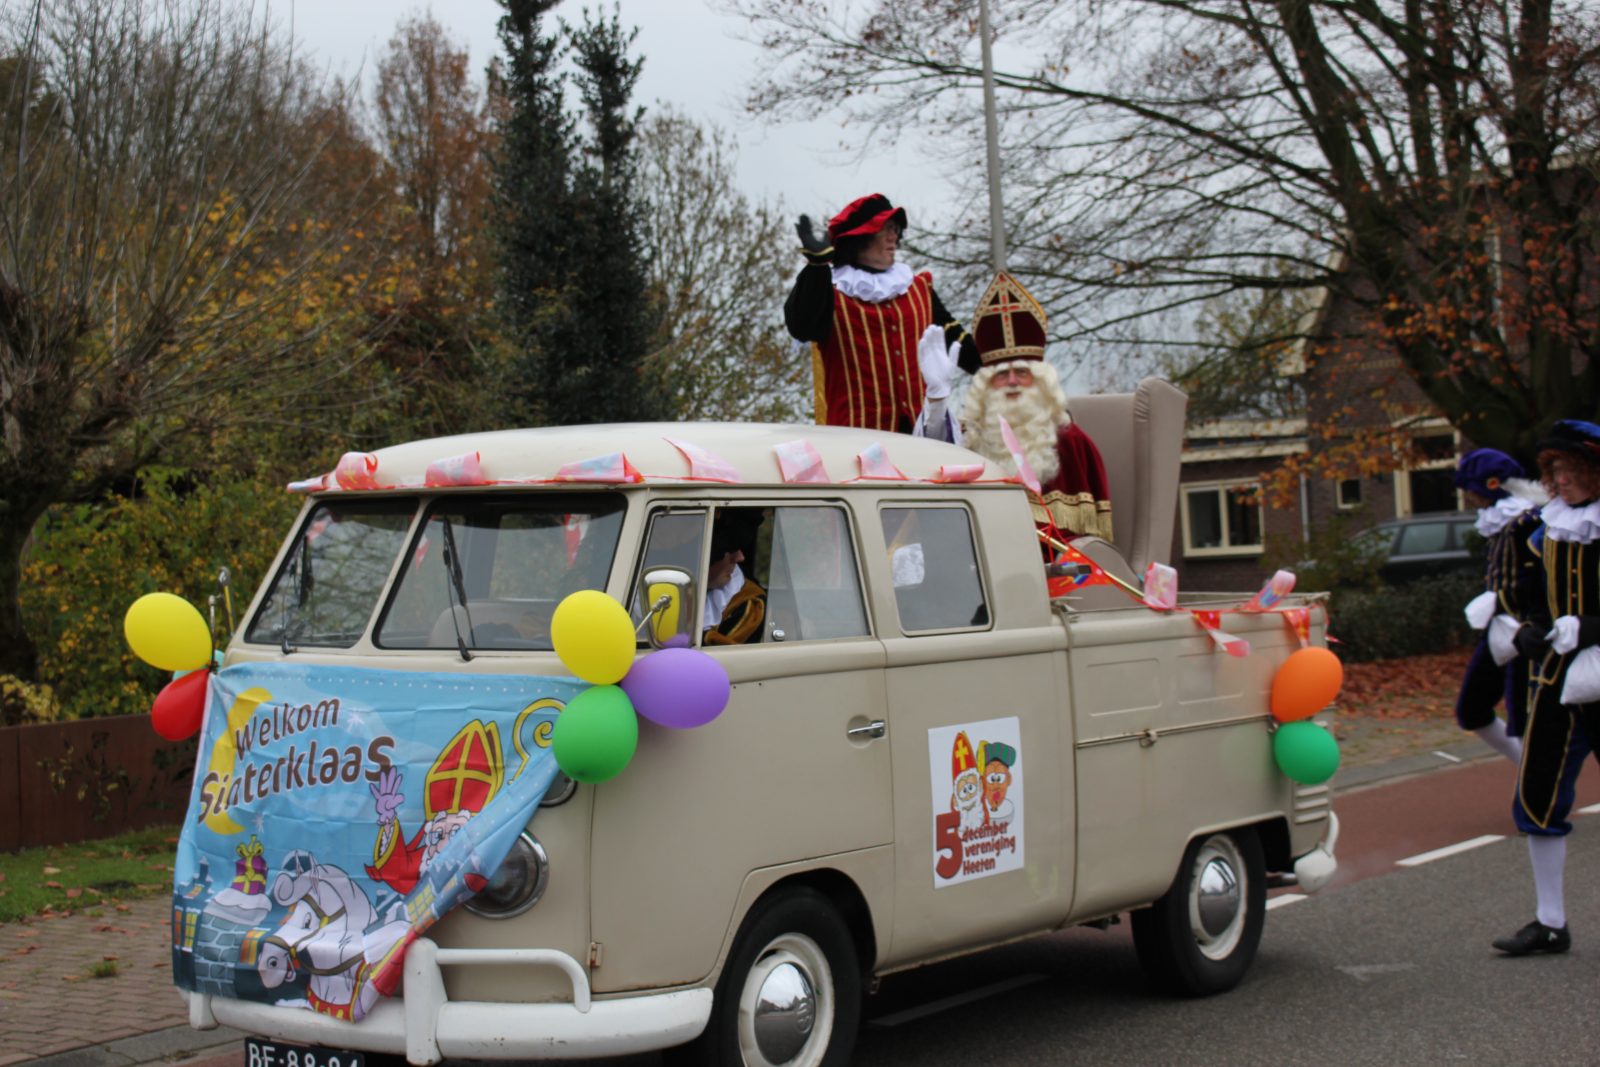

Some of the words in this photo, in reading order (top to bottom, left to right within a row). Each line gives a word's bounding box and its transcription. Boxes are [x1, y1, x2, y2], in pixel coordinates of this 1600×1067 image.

[235, 698, 341, 761] Welkom
[936, 812, 963, 879] 5
[962, 821, 1009, 843] december
[965, 835, 1016, 857] vereniging
